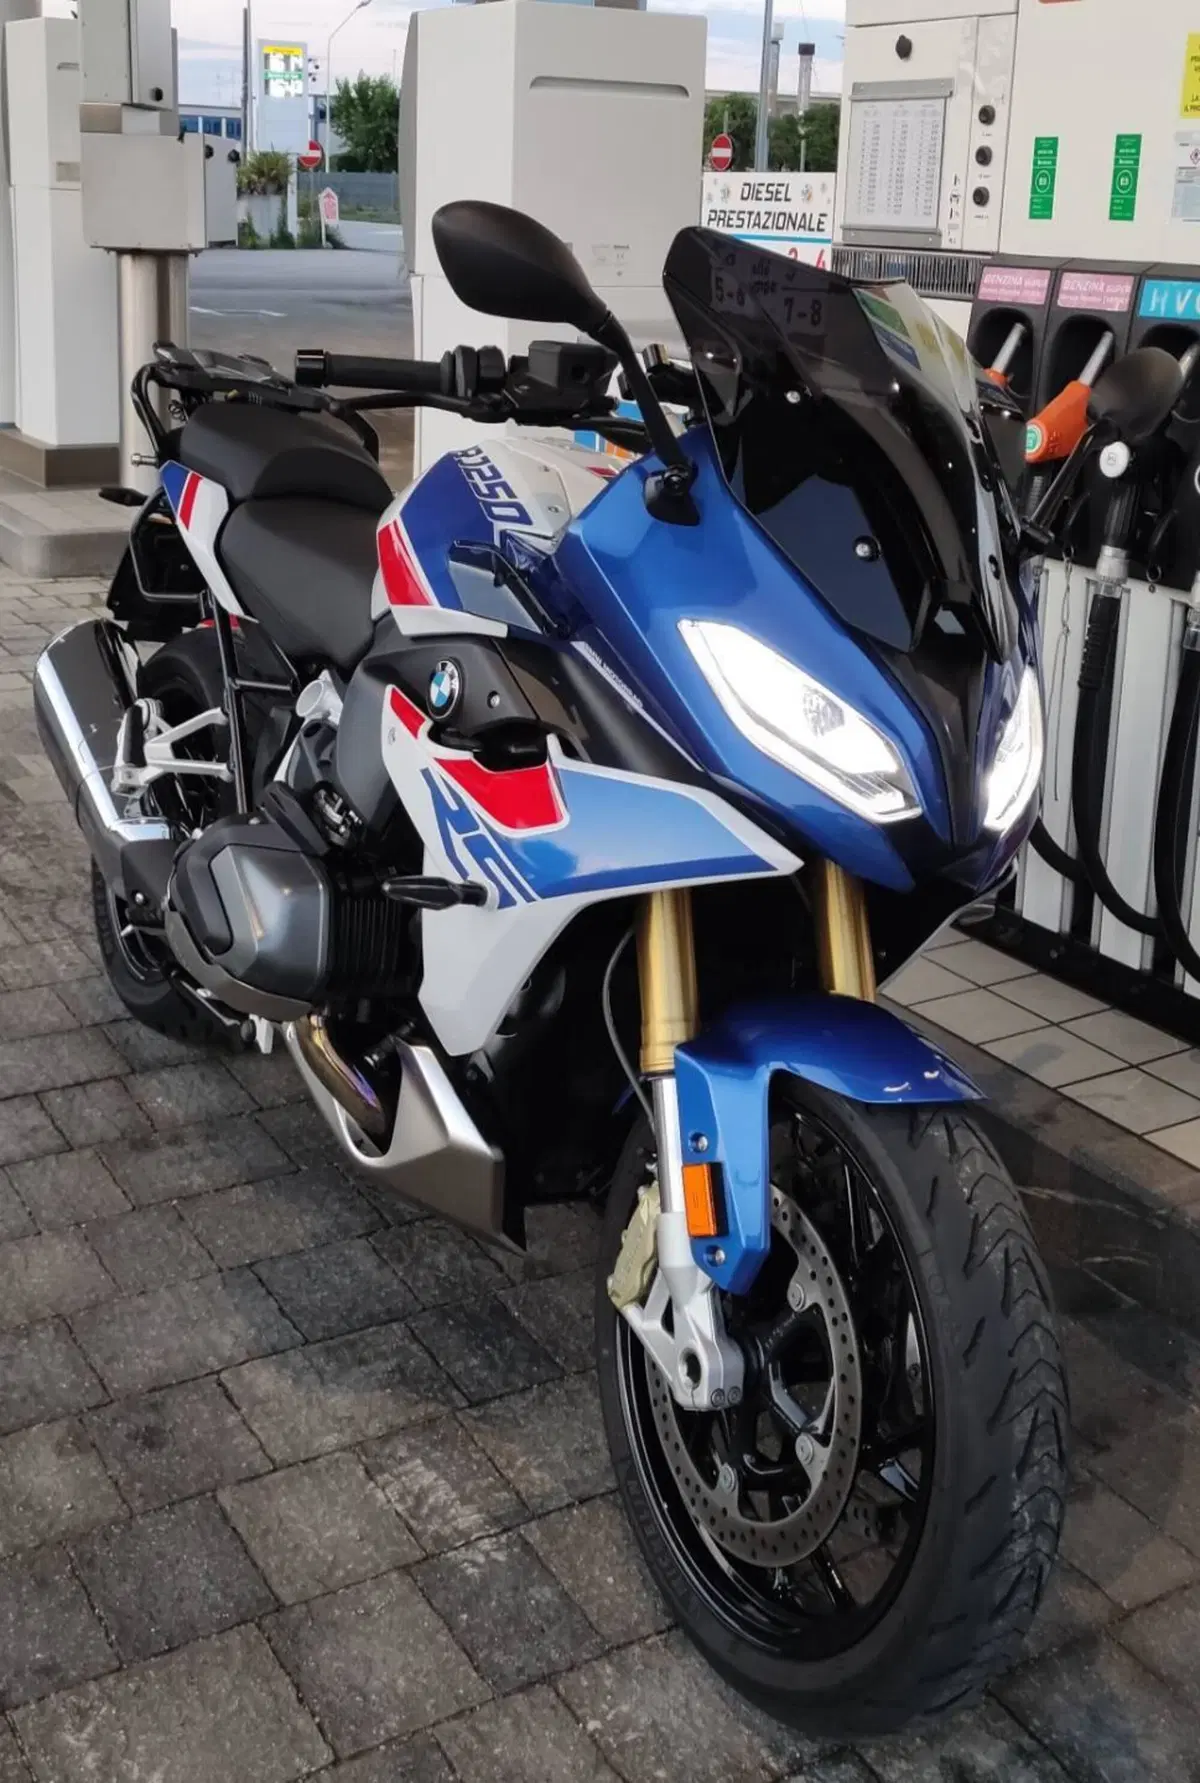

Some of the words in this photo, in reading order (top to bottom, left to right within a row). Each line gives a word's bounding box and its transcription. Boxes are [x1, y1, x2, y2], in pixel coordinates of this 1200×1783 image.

[740, 182, 792, 202] DIESEL
[707, 209, 828, 232] PRESTAZIONALE
[1148, 286, 1200, 318] HV
